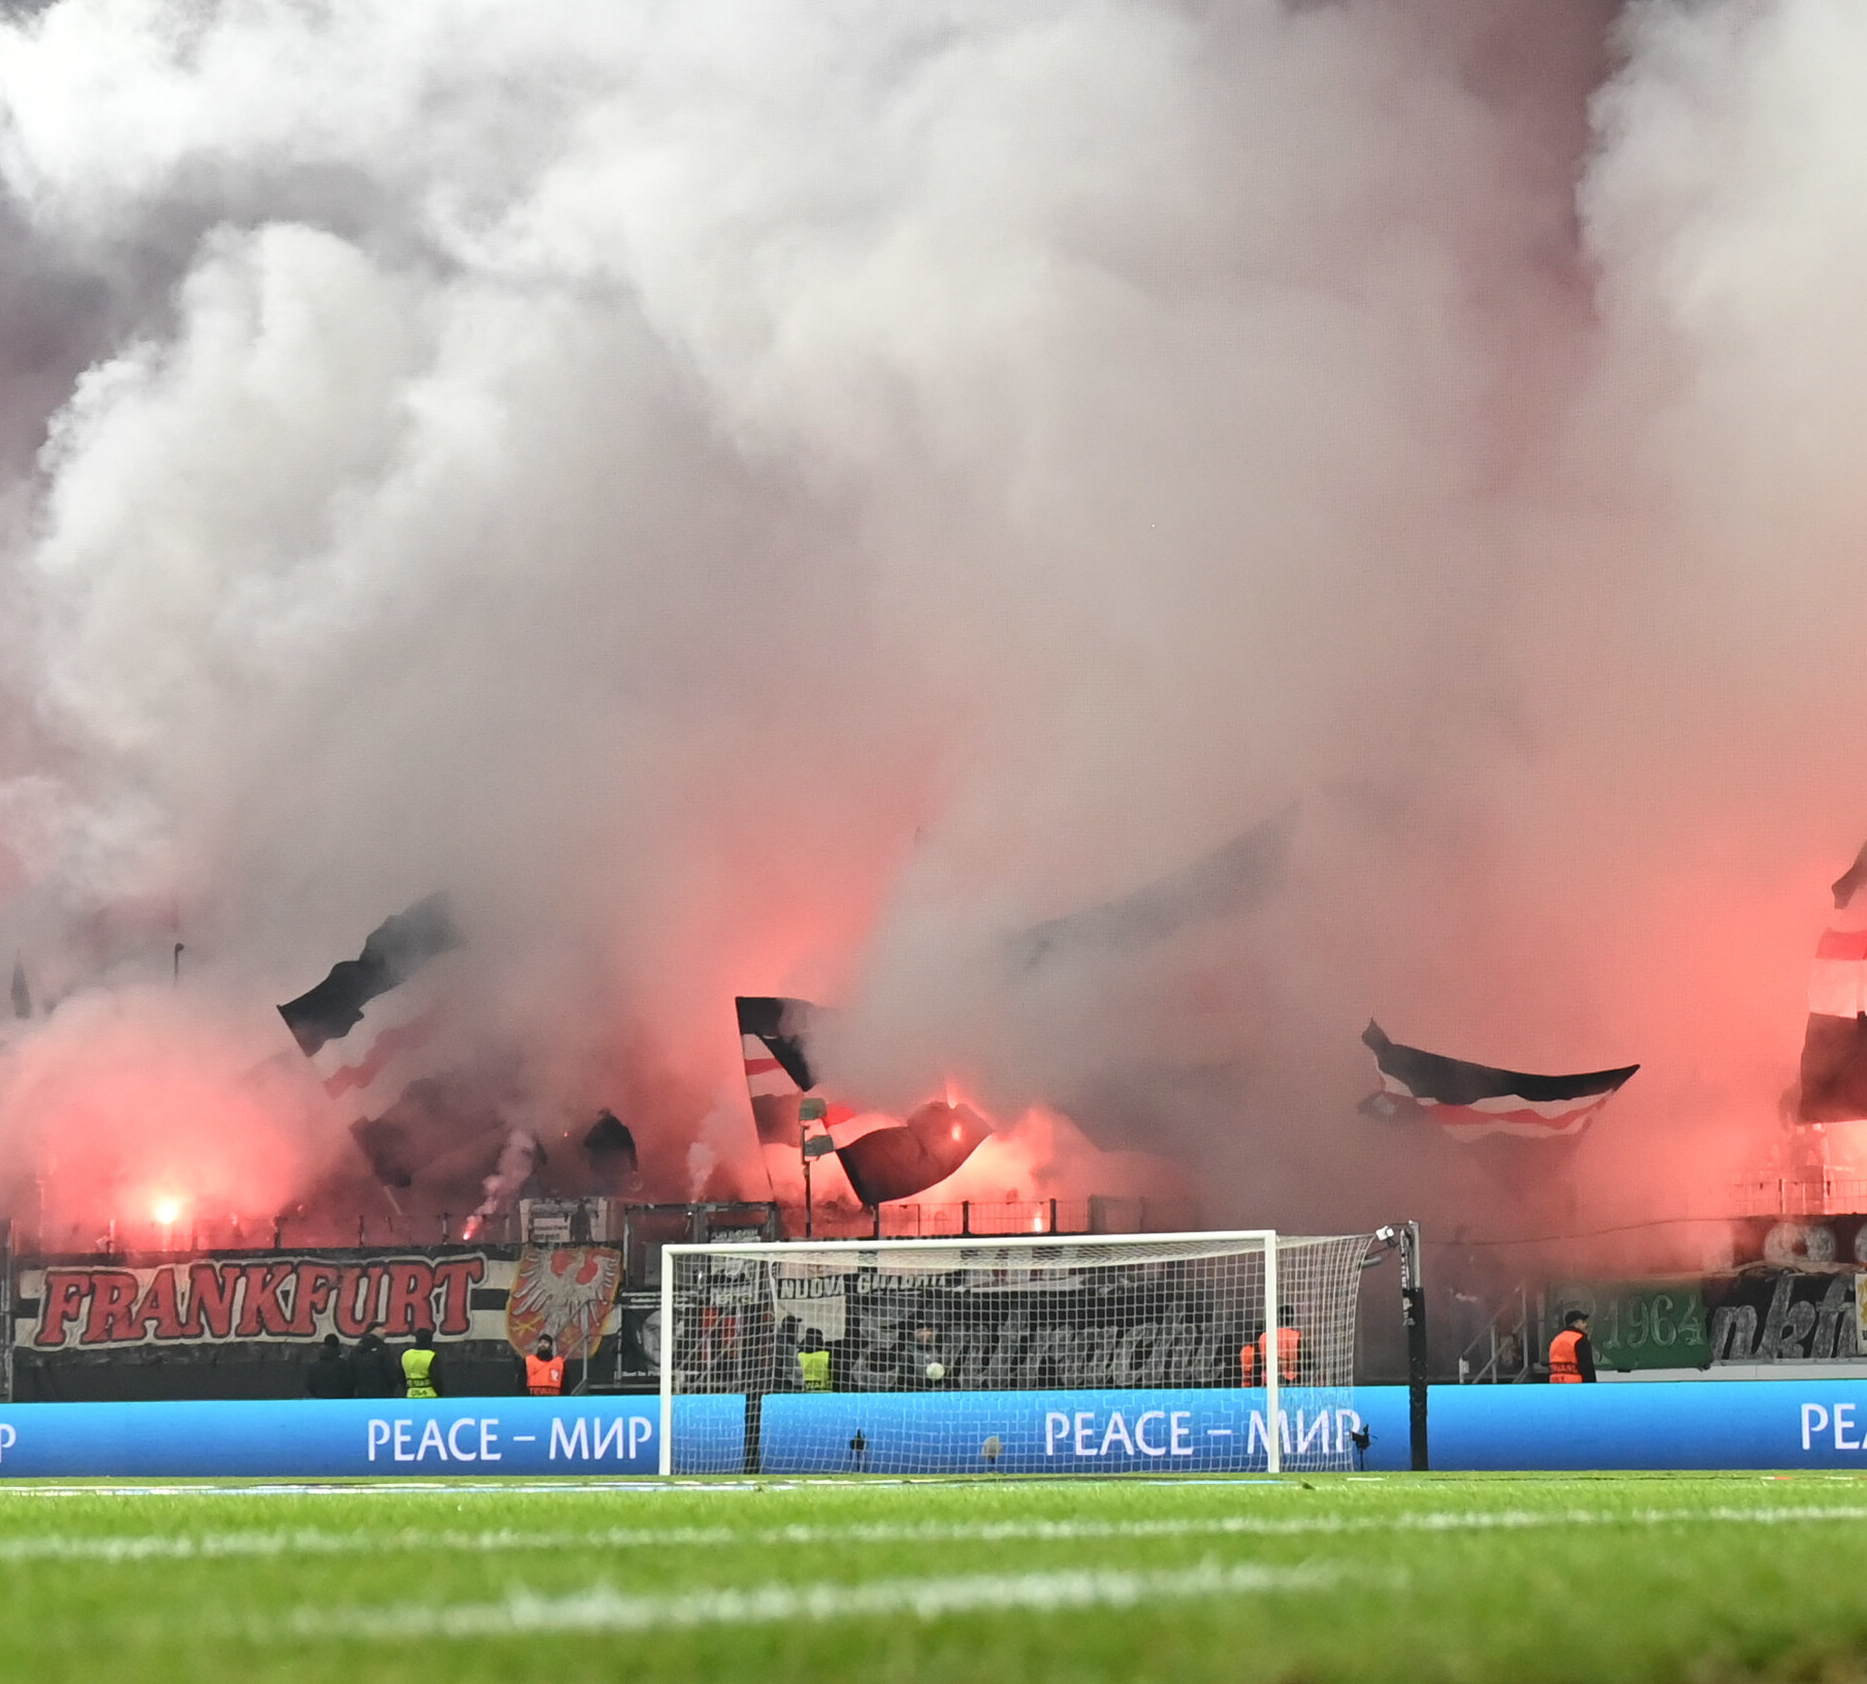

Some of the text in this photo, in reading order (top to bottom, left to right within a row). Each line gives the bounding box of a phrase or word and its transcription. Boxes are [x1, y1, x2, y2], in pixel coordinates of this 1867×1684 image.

[36, 1256, 487, 1347] FRANKFURT
[1603, 1294, 1705, 1349] 1964
[367, 1418, 502, 1461] PEACE
[1045, 1411, 1194, 1456] PEACE
